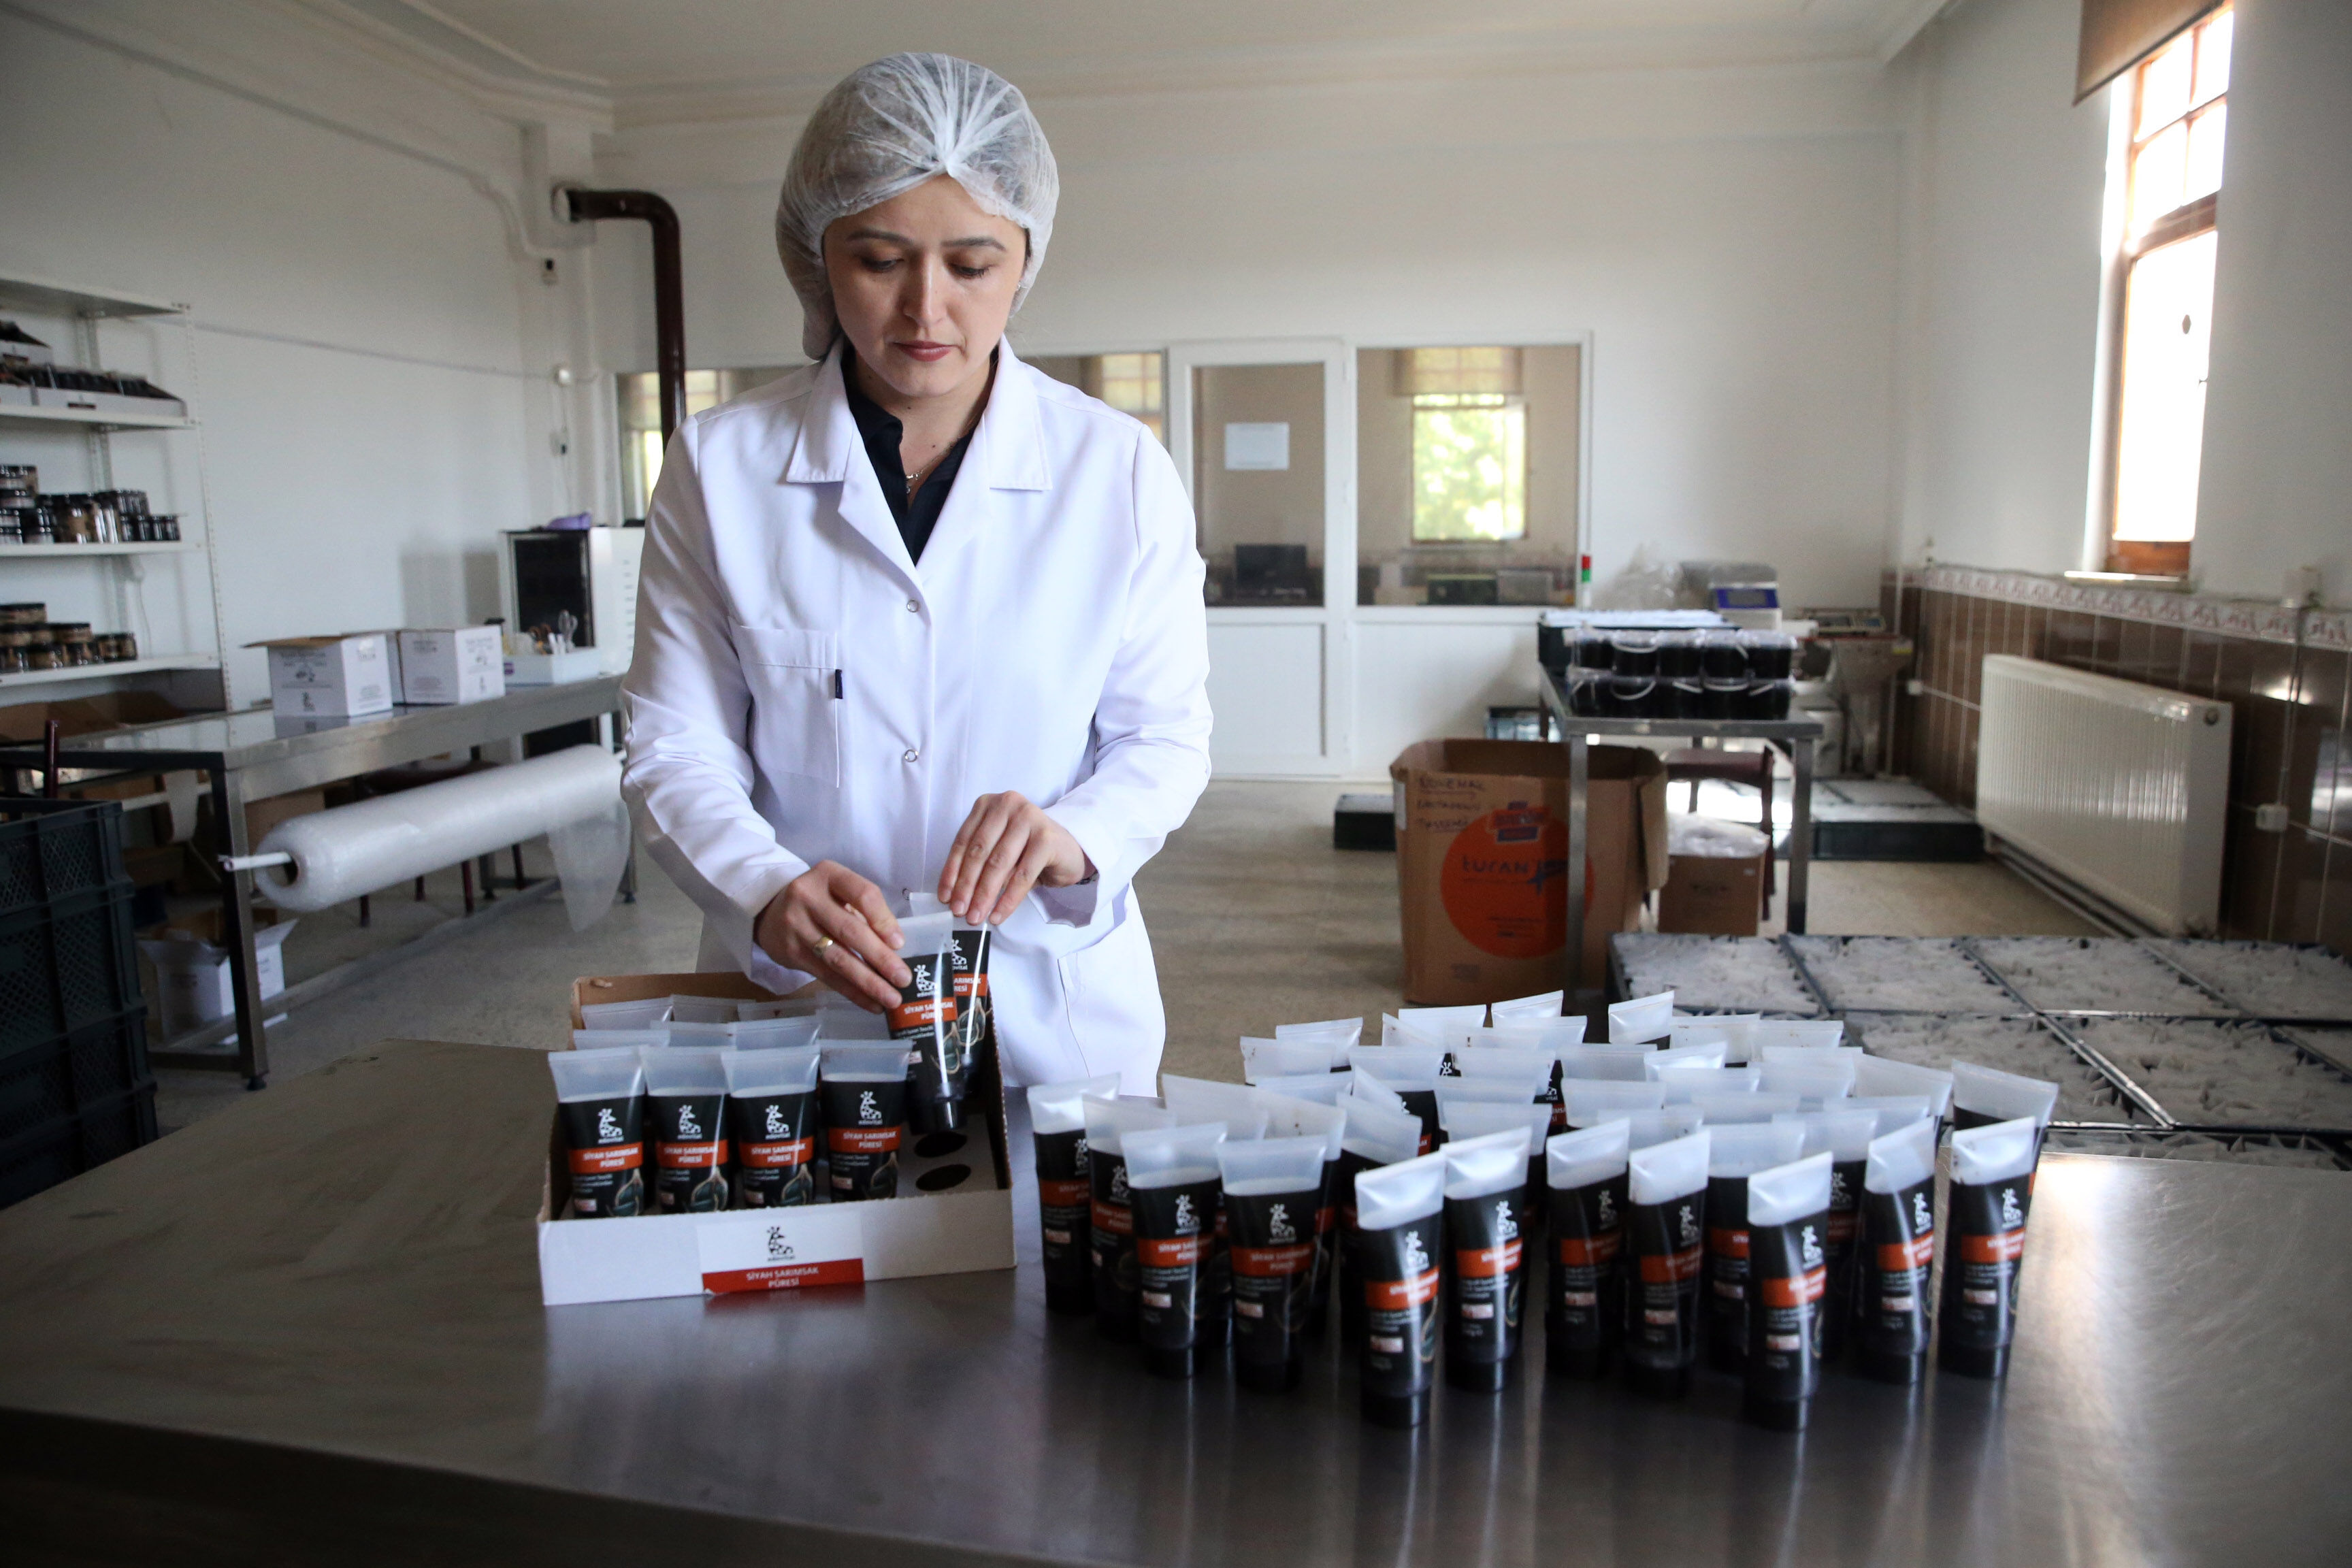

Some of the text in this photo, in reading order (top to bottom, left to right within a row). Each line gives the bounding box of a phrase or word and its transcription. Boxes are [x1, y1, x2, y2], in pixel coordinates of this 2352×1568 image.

[746, 1267, 819, 1281] SİYAH SARIMSAK
[768, 1277, 800, 1288] PÜRESİ
